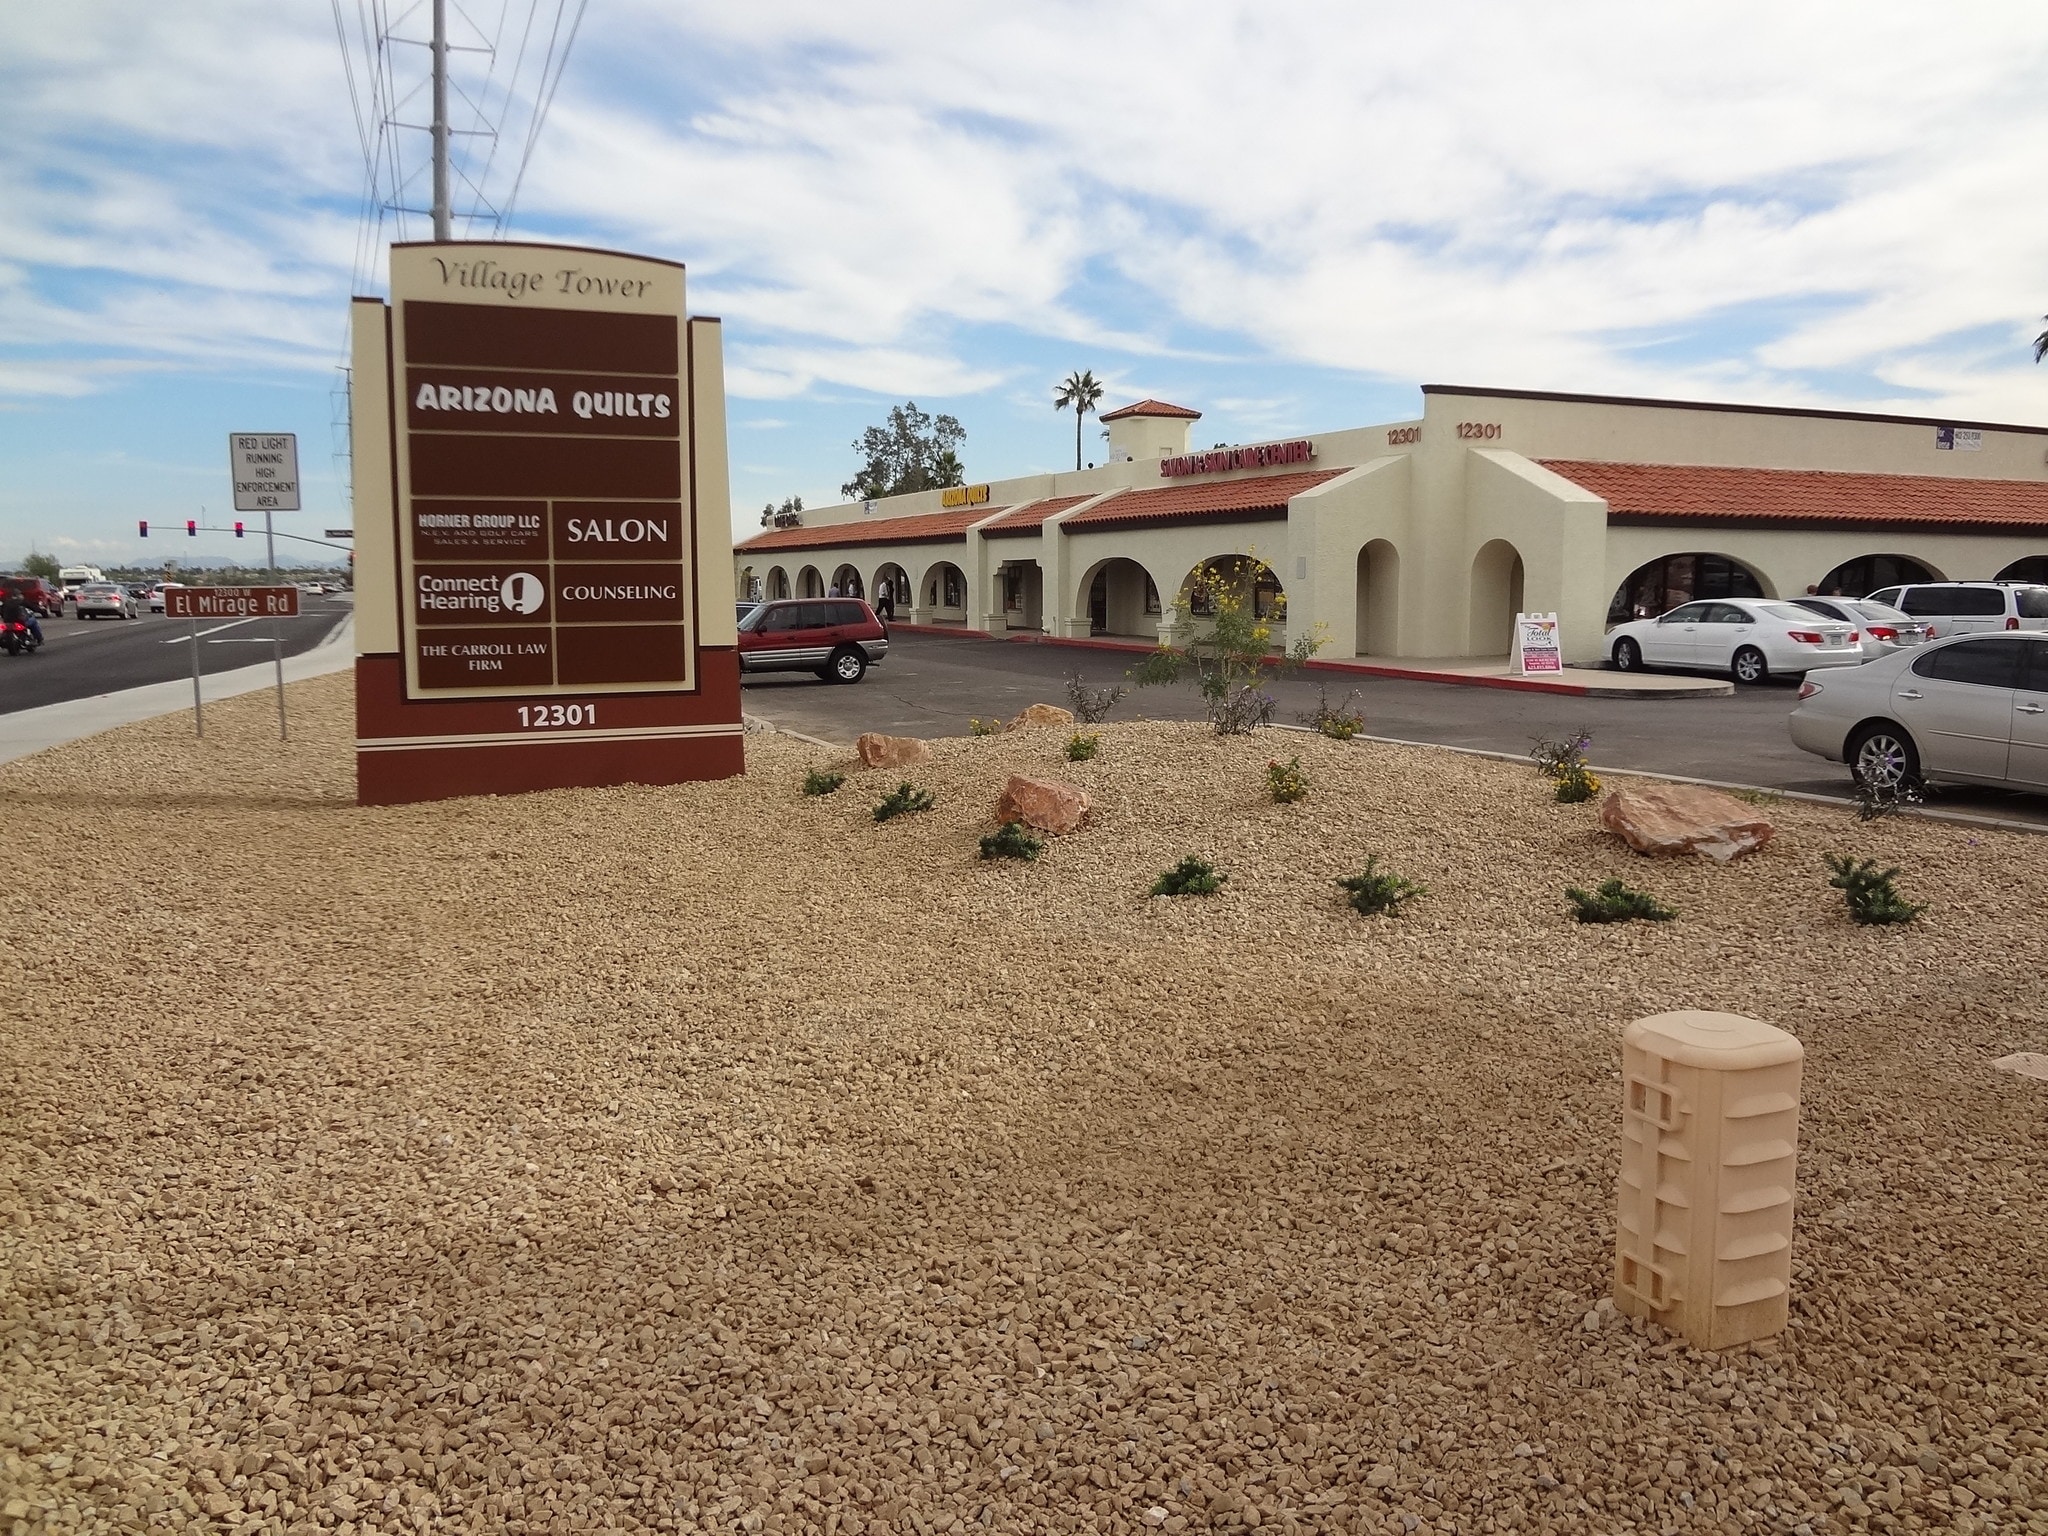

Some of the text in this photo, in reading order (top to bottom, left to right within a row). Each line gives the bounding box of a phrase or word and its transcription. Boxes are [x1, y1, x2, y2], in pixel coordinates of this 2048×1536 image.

[430, 257, 653, 300] Village Tower
[416, 384, 672, 419] ARIZONA QUILTS
[1386, 426, 1422, 446] 12301
[1456, 422, 1502, 440] 12301
[238, 437, 288, 450] RED LIGHT
[245, 453, 284, 464] RUNNING
[255, 467, 275, 478] HIGH
[236, 481, 296, 493] ENFORCEMENT
[256, 495, 279, 507] AREA
[418, 513, 541, 529] HORNER GROUP LLC
[567, 518, 668, 543] SALON
[482, 538, 528, 546] SERVICE
[419, 574, 500, 592] Connect
[213, 588, 252, 597] 12300 W
[562, 585, 677, 600] COUNSELING
[175, 594, 290, 616] El Mirage Rd
[420, 593, 500, 613] Hearing
[421, 643, 548, 657] THE CARROLL LAW
[468, 659, 503, 671] FIRM
[517, 703, 597, 727] 12301
